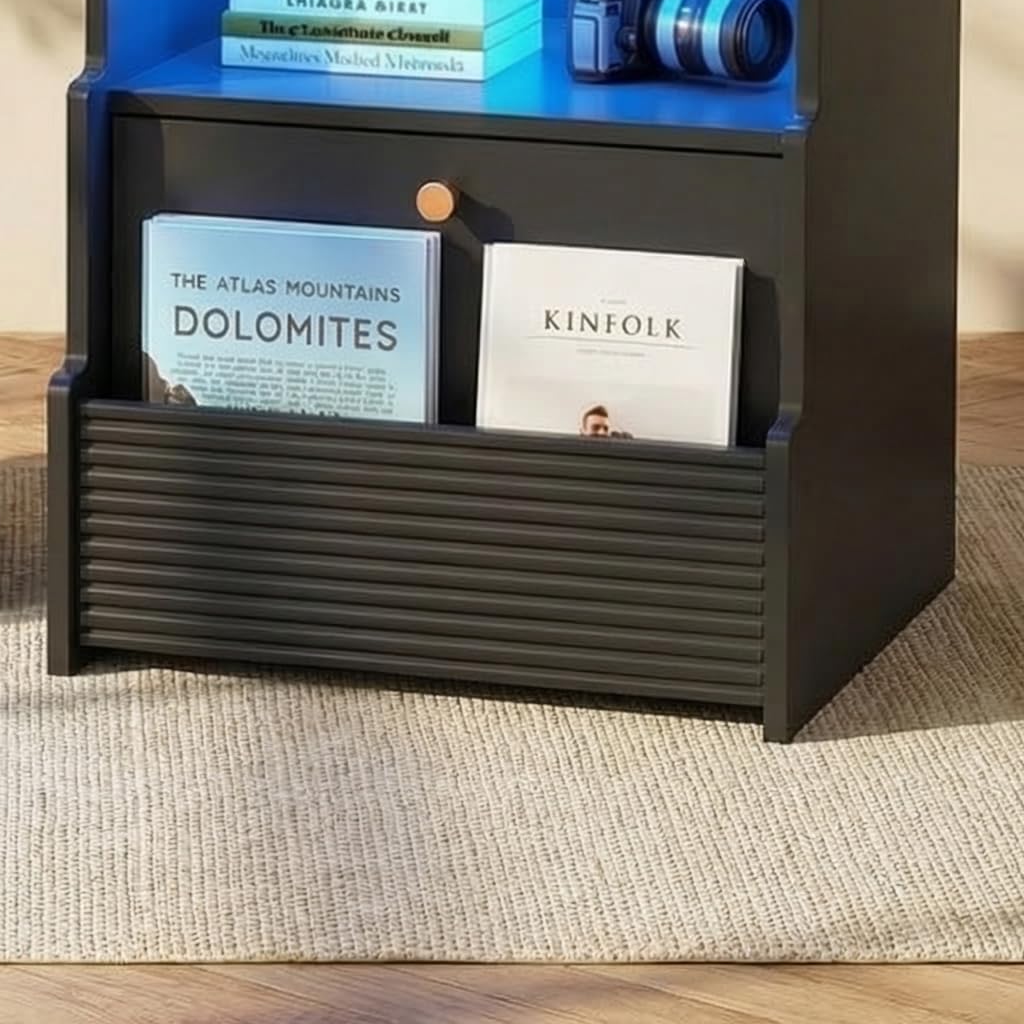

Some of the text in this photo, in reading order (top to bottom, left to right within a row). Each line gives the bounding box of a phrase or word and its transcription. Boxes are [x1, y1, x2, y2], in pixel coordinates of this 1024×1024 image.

[171, 272, 401, 304] THE ATLAS MOUNTAINS
[174, 304, 398, 352] DOLOMITES
[544, 309, 682, 340] KINFOLK
